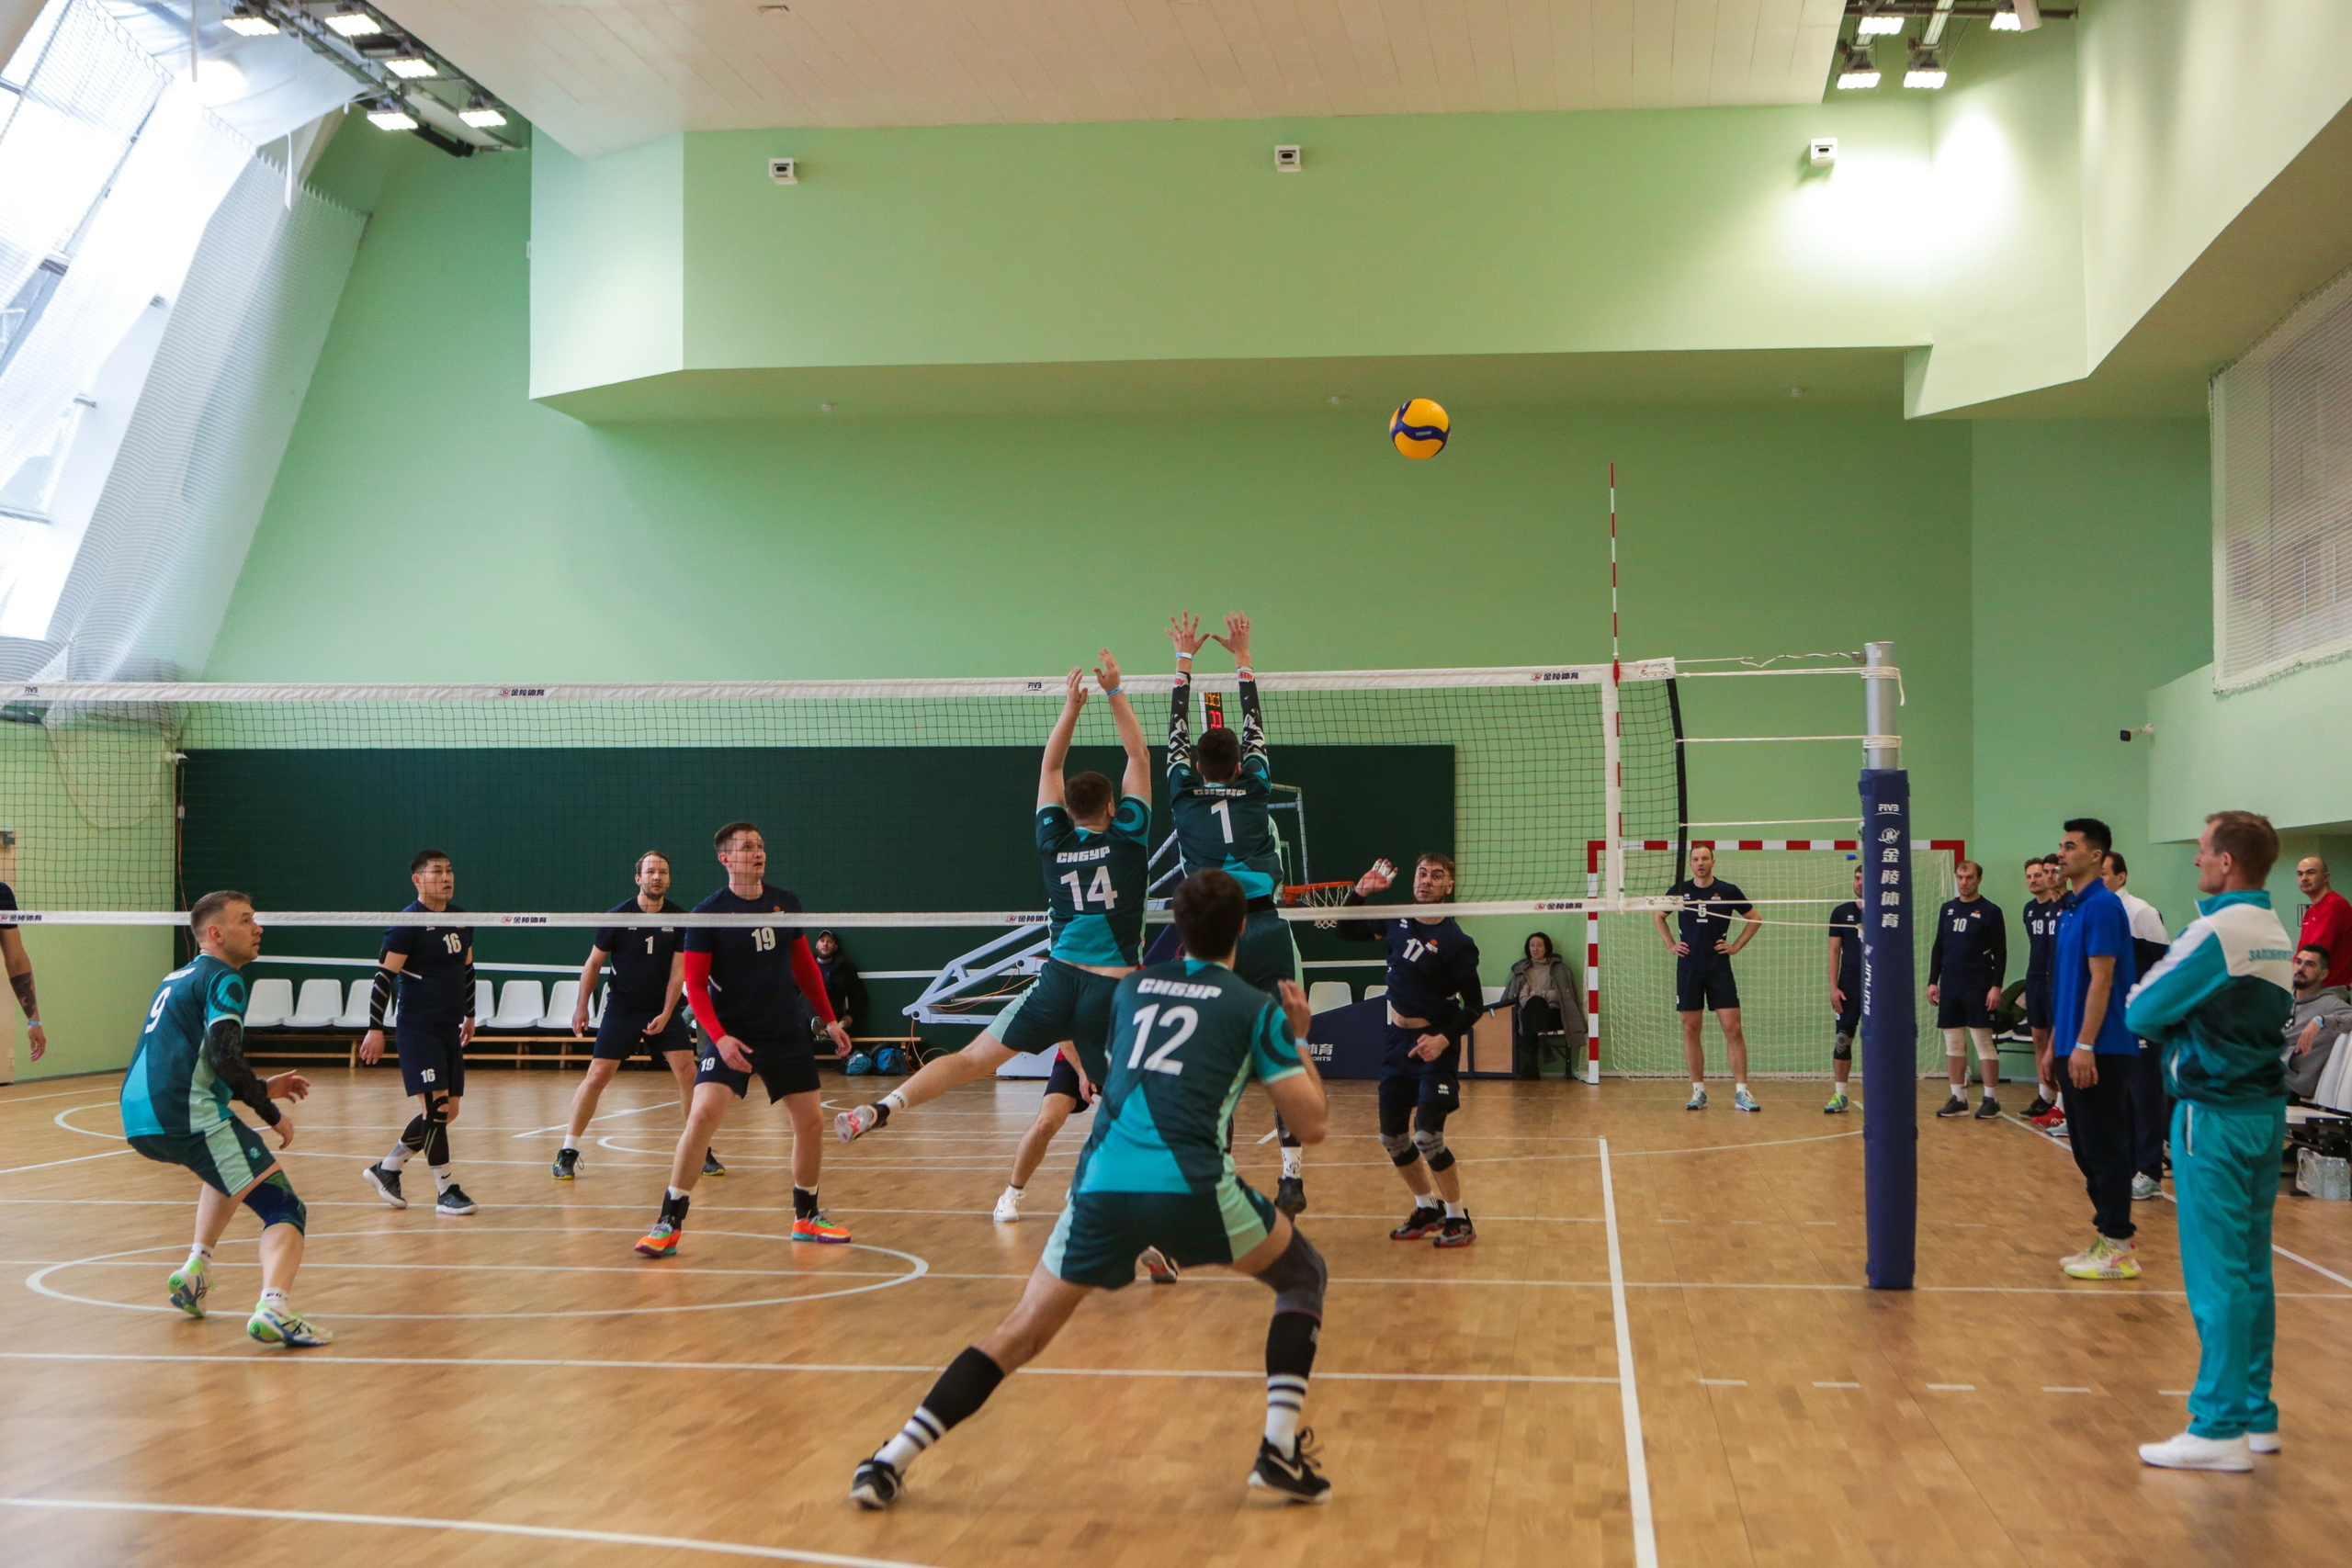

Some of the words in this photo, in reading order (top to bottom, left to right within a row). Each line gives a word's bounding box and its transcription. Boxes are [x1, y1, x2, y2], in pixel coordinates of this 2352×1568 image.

[1210, 799, 1234, 844] 1
[1056, 845, 1111, 863] СИБУР
[1060, 865, 1118, 911] 14
[1880, 847, 1901, 929] 金陵体育
[1952, 918, 1968, 933] 10
[2030, 919, 2044, 935] 19
[442, 932, 462, 954] 16
[645, 935, 654, 954] 1
[751, 926, 776, 953] 19
[1402, 938, 1425, 963] 17
[1136, 977, 1223, 1000] СИБУР
[144, 986, 172, 1034] 9
[1126, 1003, 1199, 1076] 12
[701, 1056, 716, 1072] 19
[420, 1068, 436, 1084] 16
